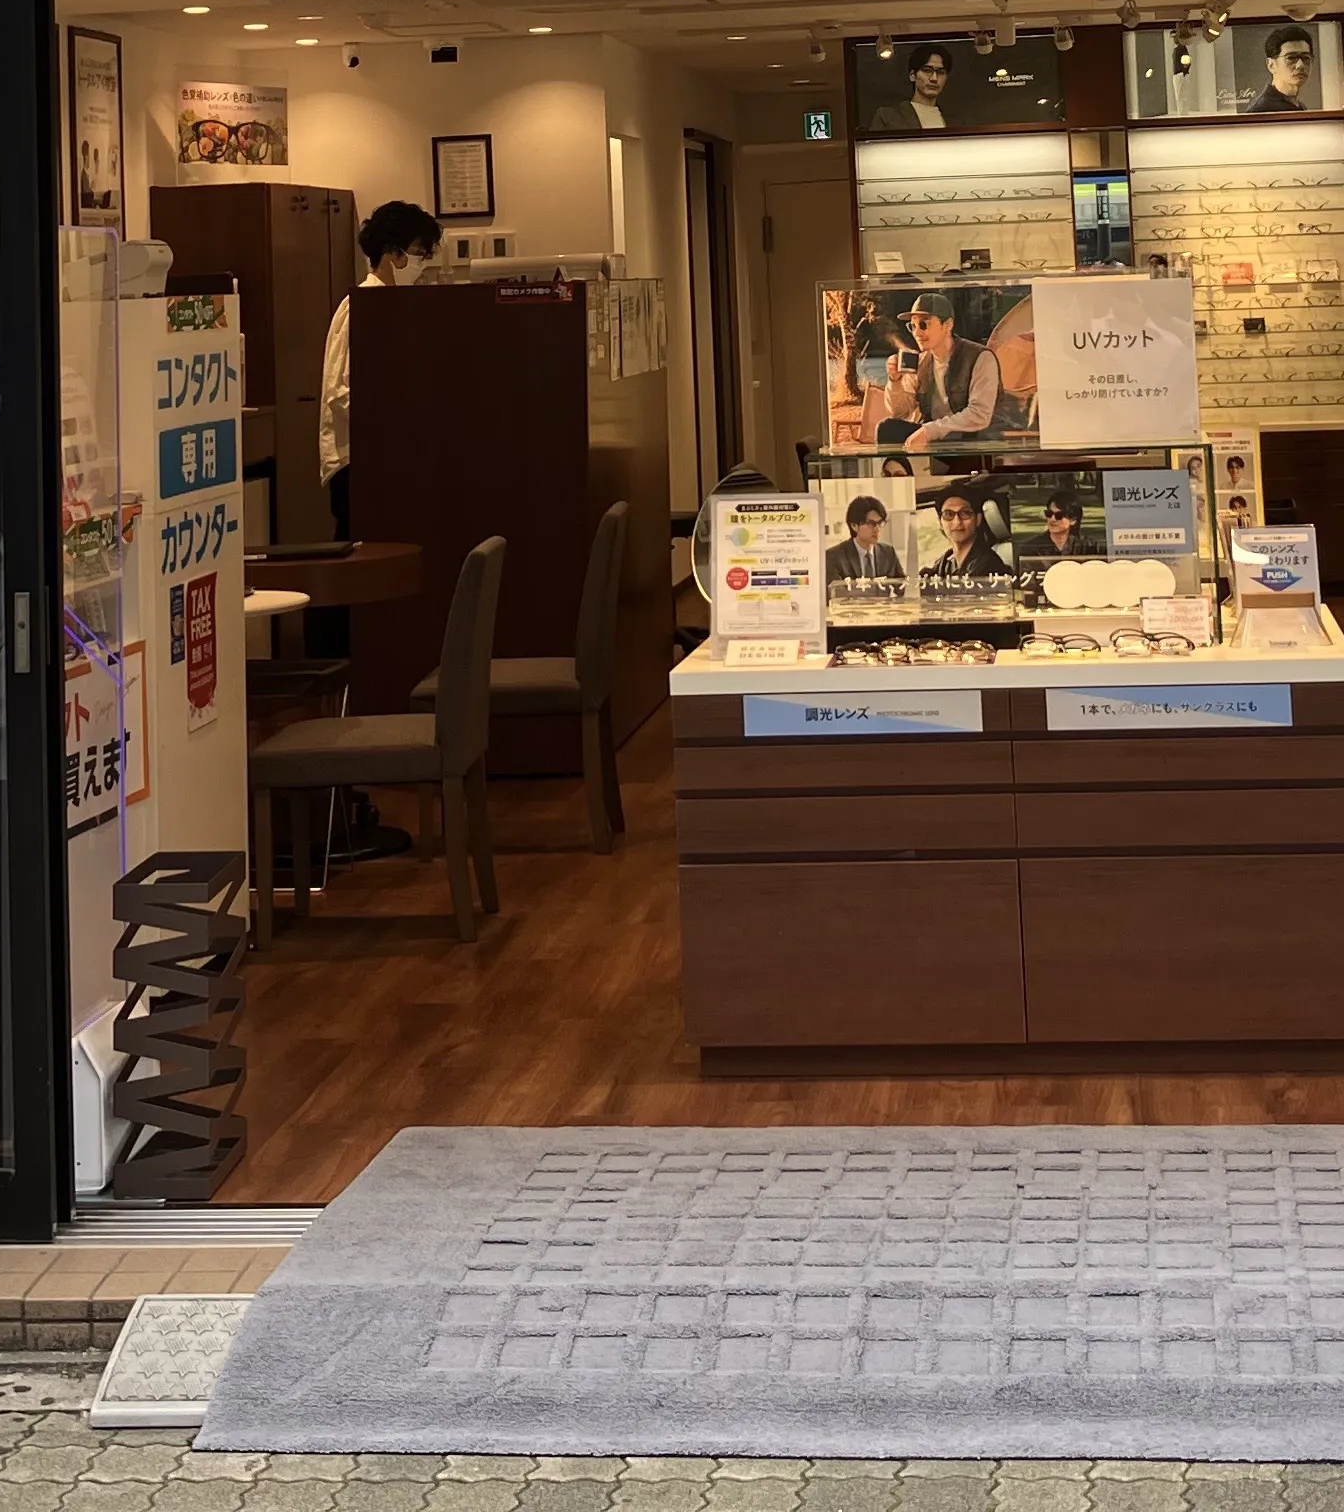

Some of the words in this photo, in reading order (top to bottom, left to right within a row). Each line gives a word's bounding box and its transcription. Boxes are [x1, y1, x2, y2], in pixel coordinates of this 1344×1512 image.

[1072, 328, 1155, 352] UVカット
[158, 350, 237, 409] コンタクト
[180, 428, 216, 485] 専用
[1111, 485, 1180, 502] 調光レンズ
[161, 504, 238, 575] カウンター
[1266, 571, 1287, 580] PUSH
[191, 584, 211, 617] TAX
[190, 613, 212, 642] FREE
[805, 706, 870, 722] 調光レンズ
